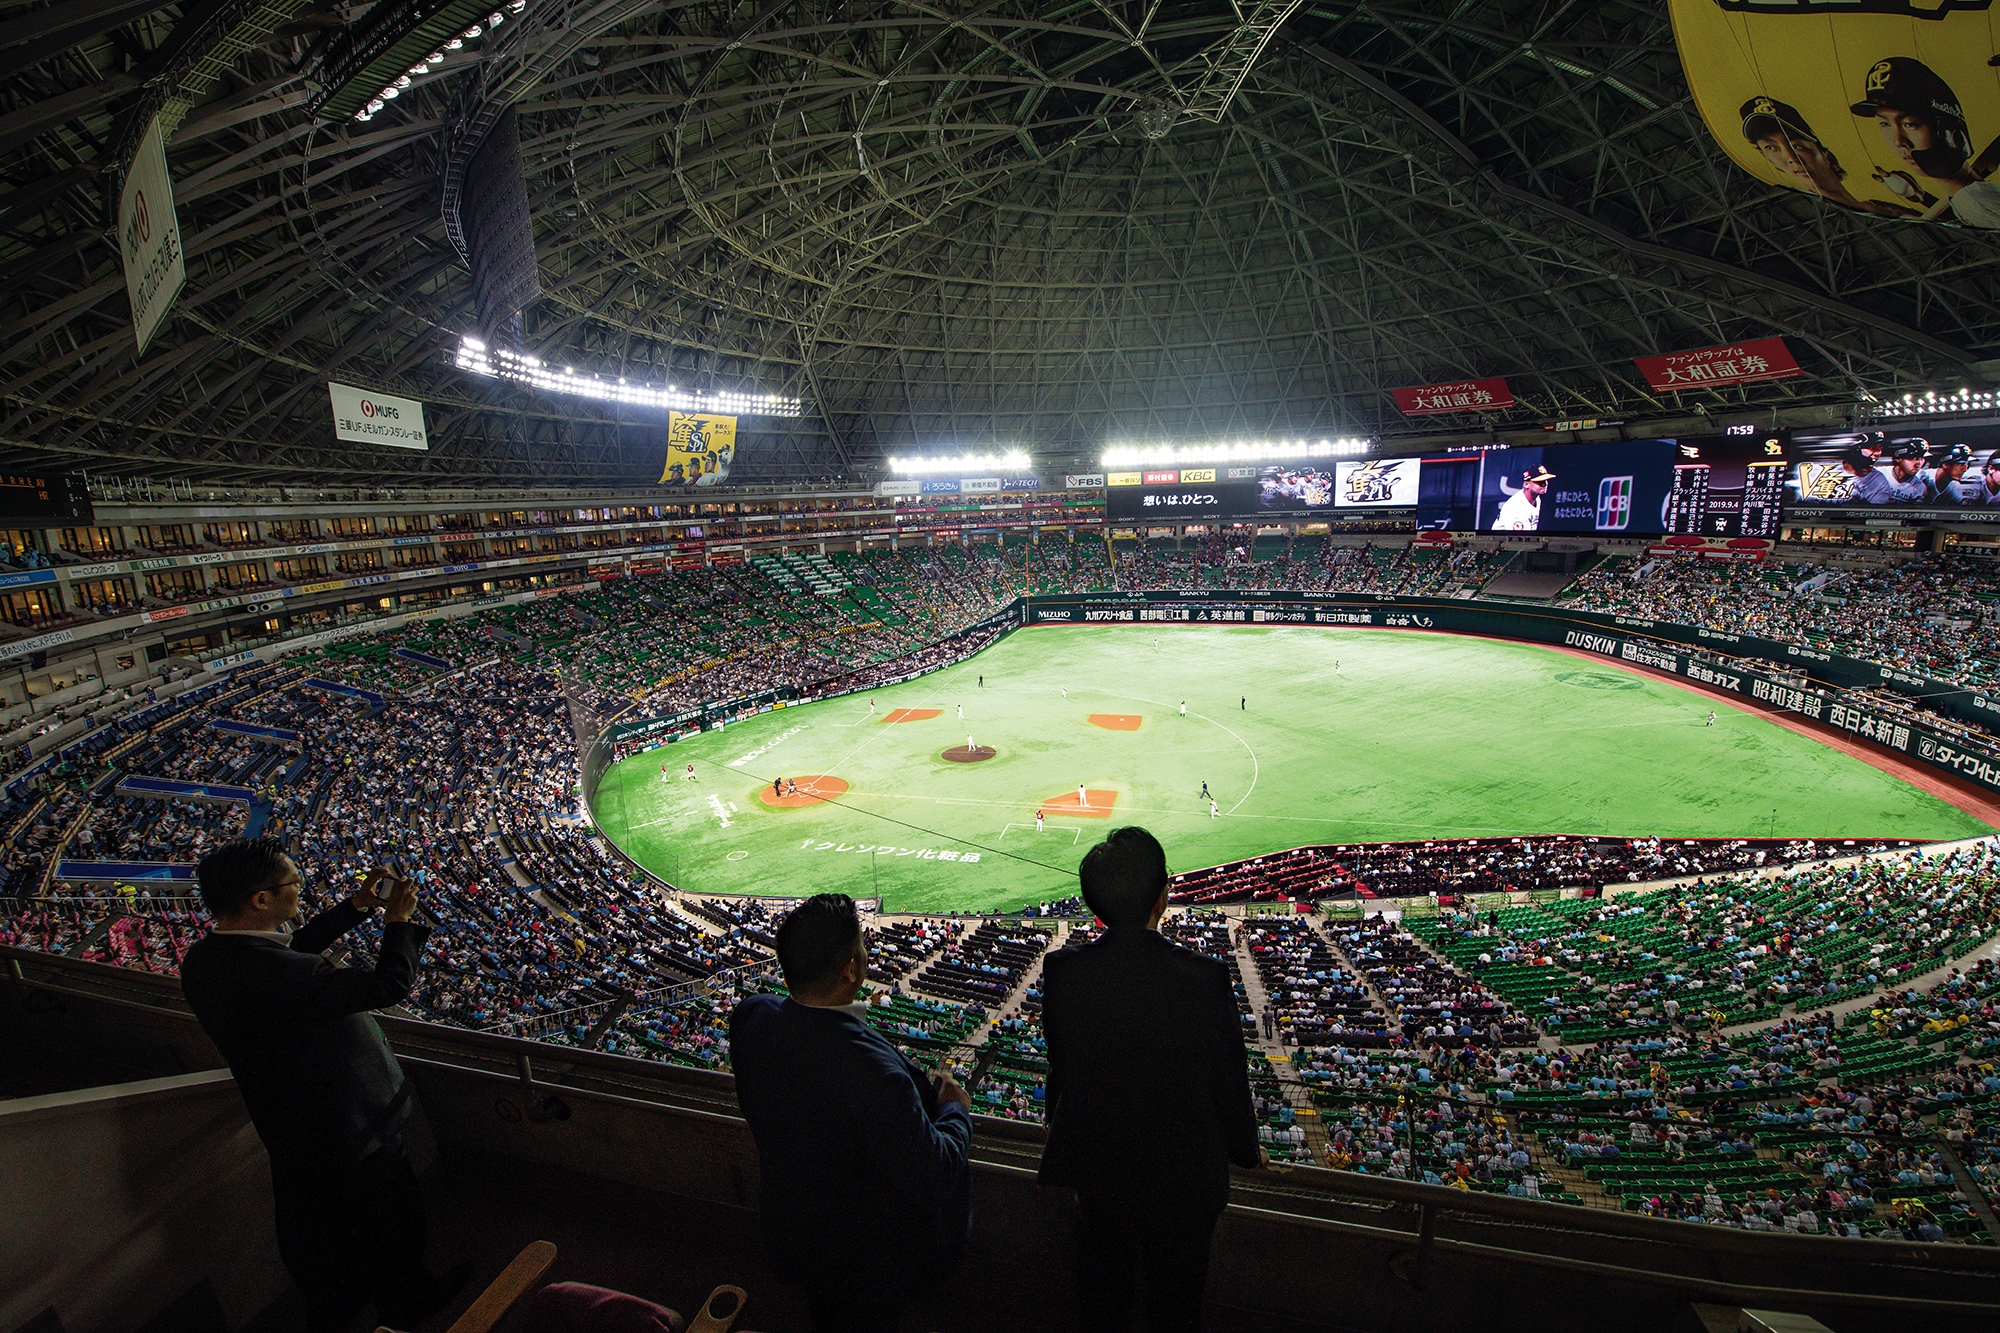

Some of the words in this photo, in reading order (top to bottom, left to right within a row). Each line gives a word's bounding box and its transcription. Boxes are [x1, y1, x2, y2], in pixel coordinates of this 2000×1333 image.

[1666, 347, 1745, 365] ファンドラップは
[1661, 356, 1769, 383] 大和証券
[1416, 383, 1477, 395] ファンドラップは
[1411, 390, 1493, 410] 大和証券
[375, 404, 399, 419] MUFG
[1727, 424, 1754, 435] 17:59
[932, 482, 958, 491] ろうきん
[1078, 478, 1102, 486] FBS
[1555, 491, 1591, 504] 世界にひとつ。
[1598, 495, 1629, 512] JCB
[1708, 501, 1739, 509] 2019.9.4
[1554, 507, 1594, 519] あなたにひとつ。
[1960, 513, 1998, 521] SONY
[1956, 546, 1992, 555] 今宮健太
[1085, 610, 1133, 621] 九州アスリート食品
[1210, 610, 1245, 621] 英進館
[1265, 611, 1307, 621] 博多グリーンホテル
[1315, 612, 1372, 624] 新日本製薬
[37, 631, 73, 647] XPERIA
[1565, 630, 1617, 655] DUSKIN
[1800, 649, 1831, 662] 福岡トヨタ
[1636, 653, 1677, 673] 住友不動産
[1687, 665, 1740, 693] 西部ガス
[1893, 672, 1926, 688] 福岡トヨタ
[1752, 679, 1822, 719] 昭和建設
[1829, 703, 1911, 751] 西日本新聞
